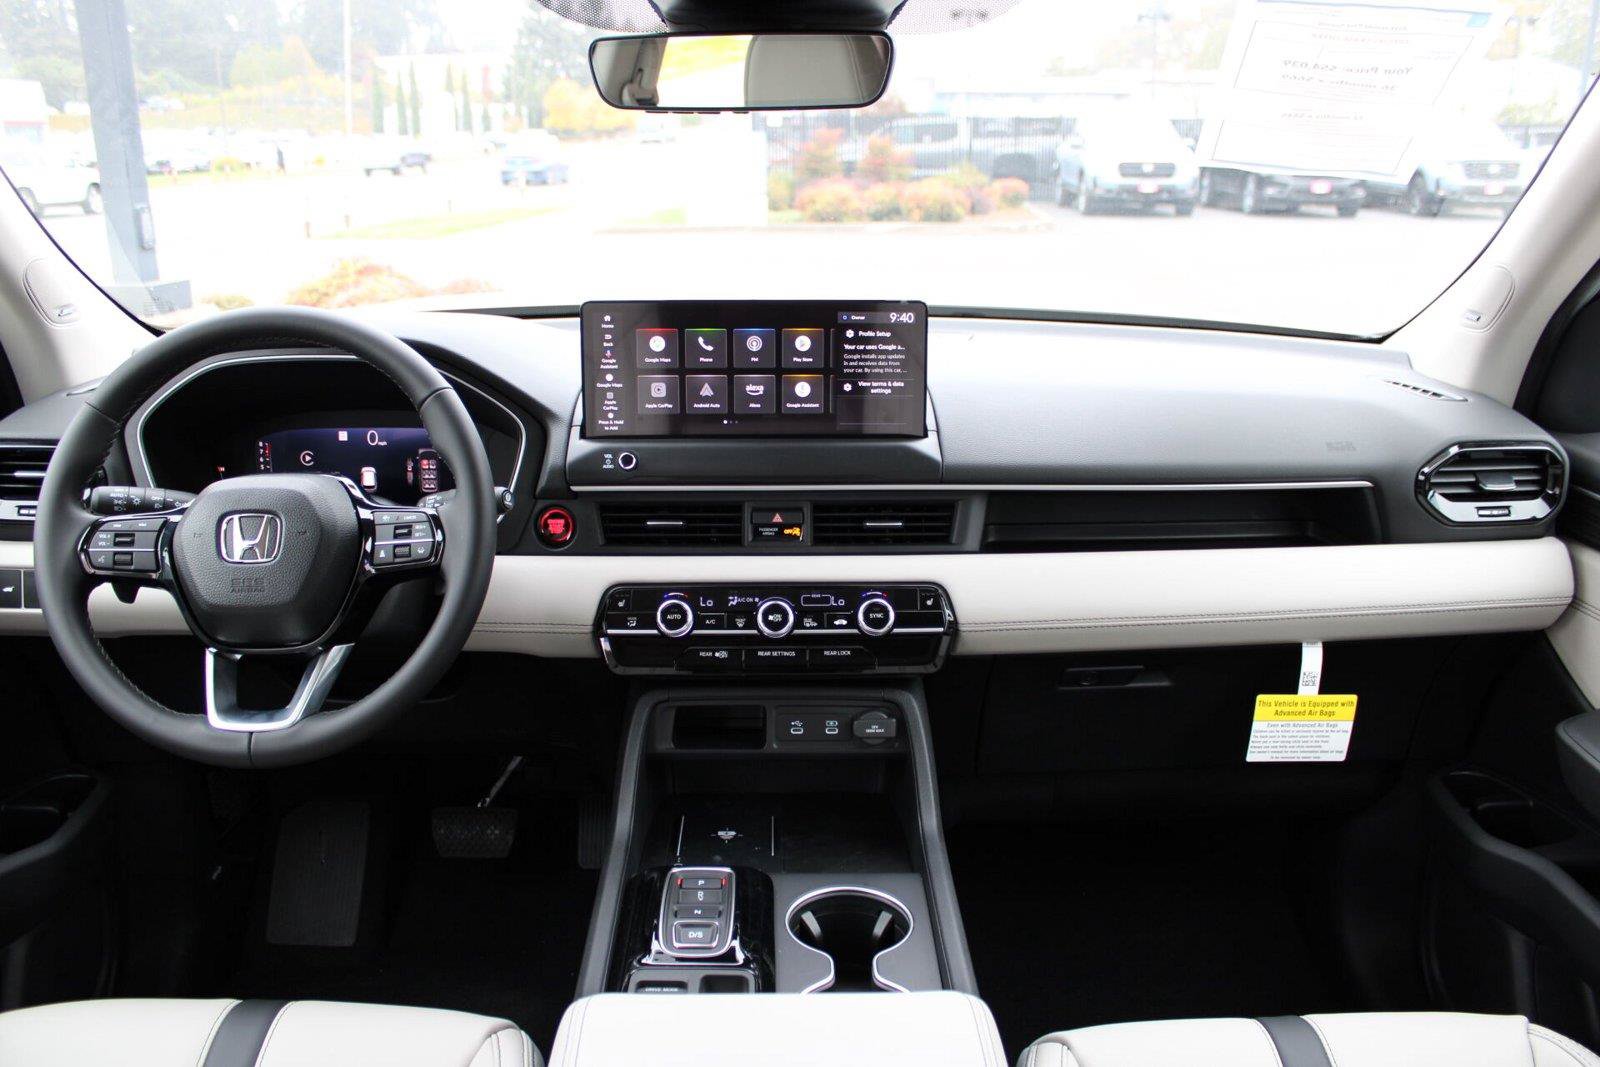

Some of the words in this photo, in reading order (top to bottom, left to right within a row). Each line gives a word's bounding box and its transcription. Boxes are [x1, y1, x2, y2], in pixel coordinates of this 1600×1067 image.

[889, 312, 914, 324] 9:40
[745, 384, 764, 392] alexa
[367, 430, 378, 446] 0
[1308, 701, 1339, 709] Equipped
[1274, 709, 1306, 717] Advanced
[688, 931, 704, 939] D/S
